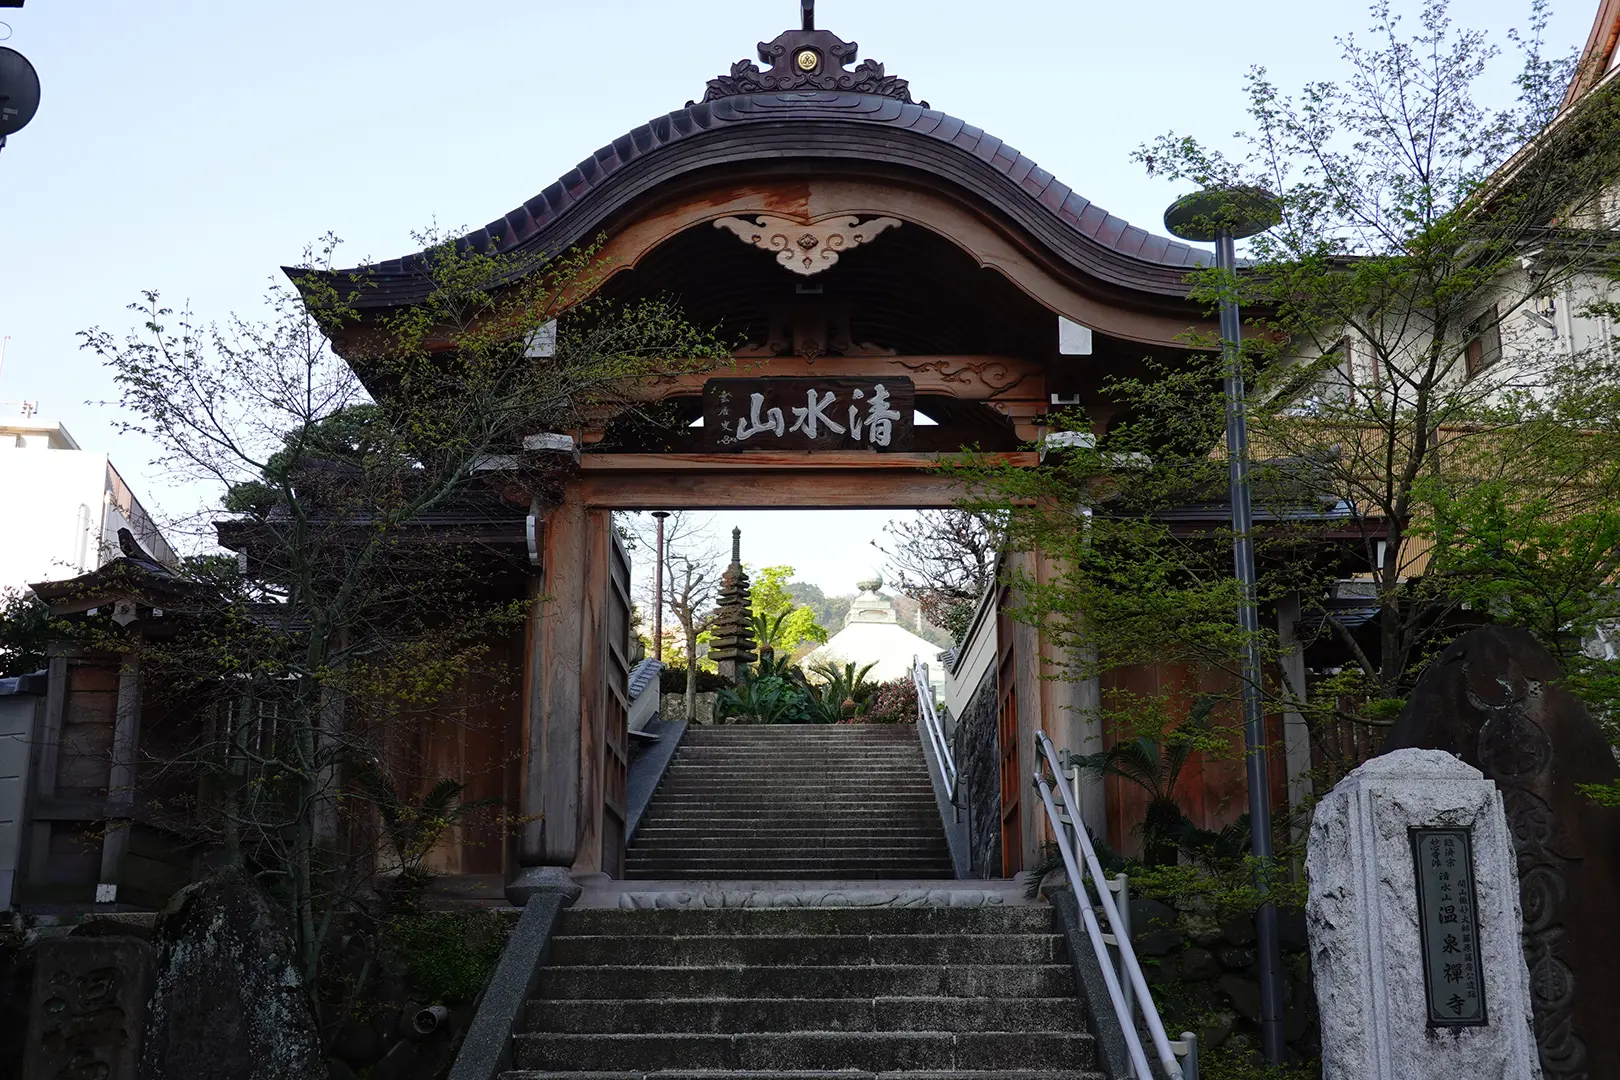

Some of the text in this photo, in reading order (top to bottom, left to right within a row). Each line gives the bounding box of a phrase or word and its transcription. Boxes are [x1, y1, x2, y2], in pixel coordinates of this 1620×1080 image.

[736, 383, 901, 447] 清水山
[1438, 871, 1453, 902] 清水山
